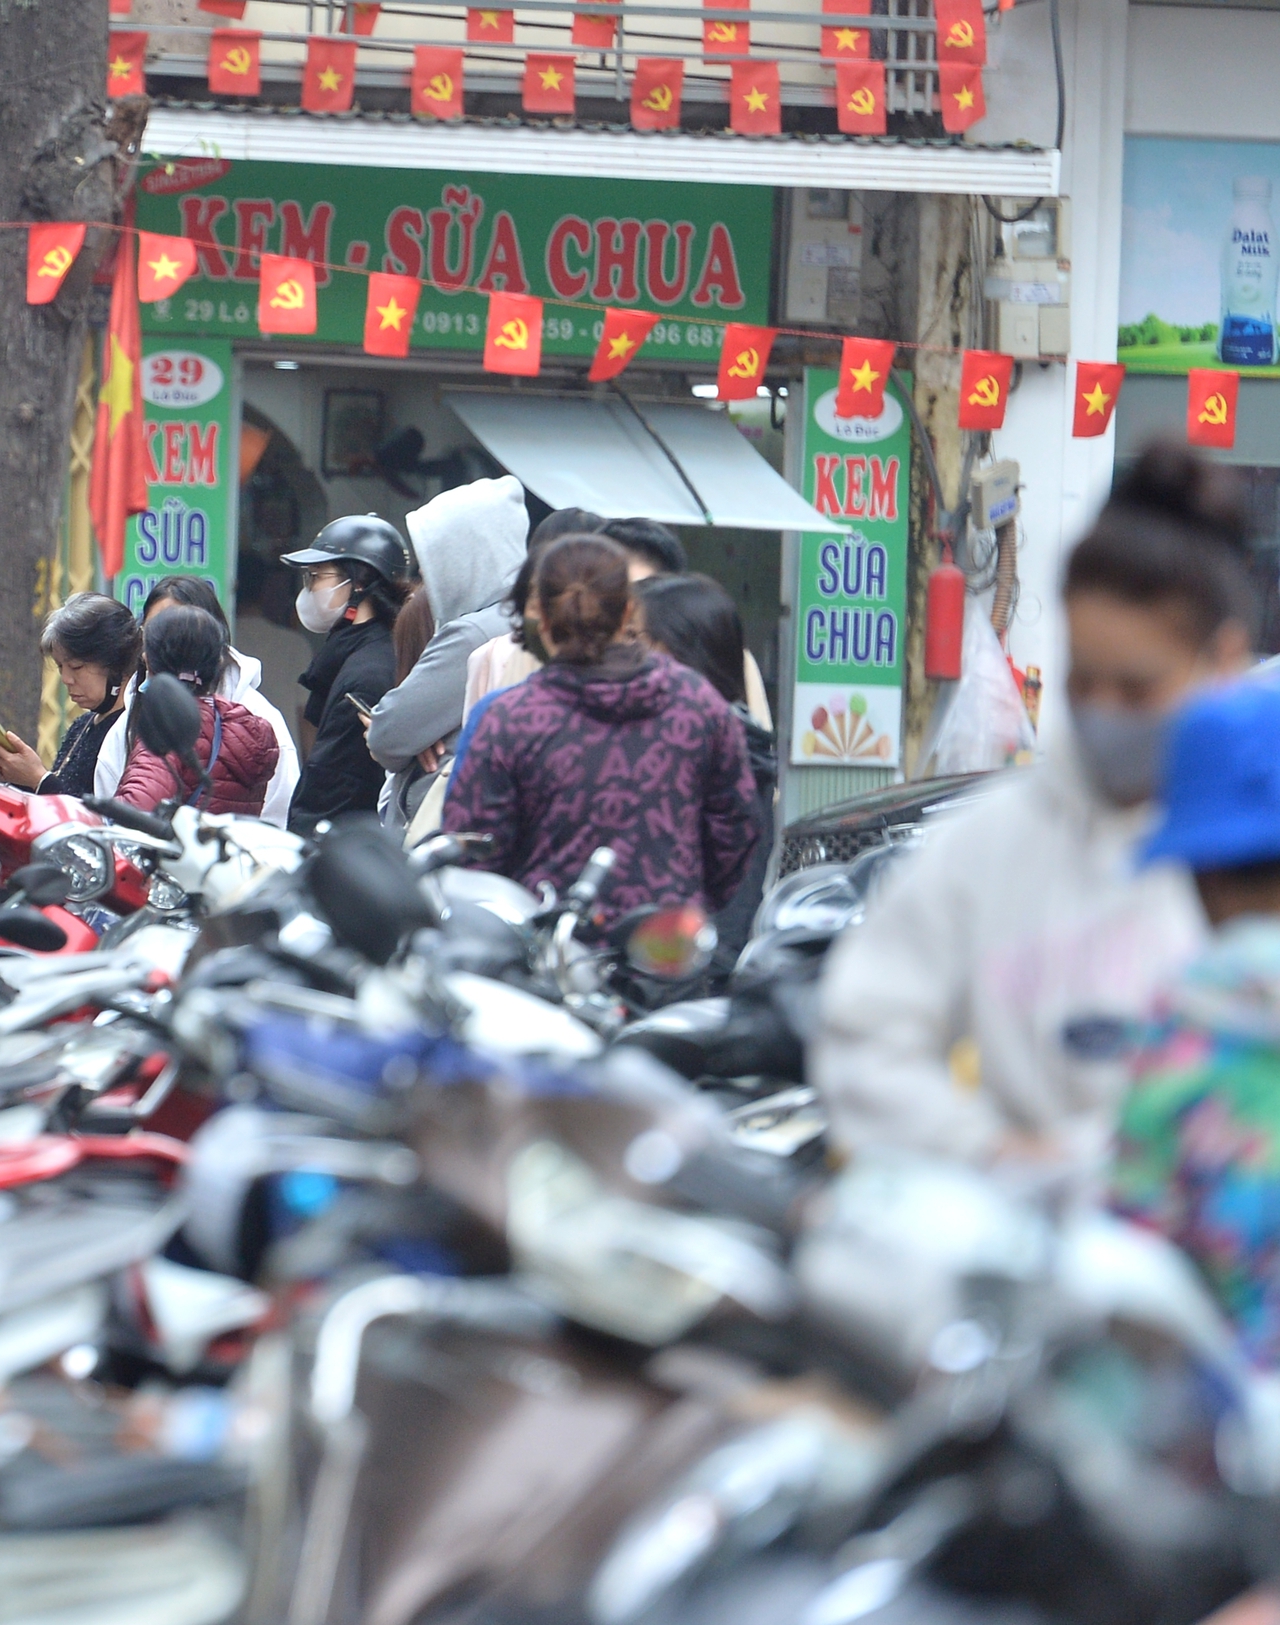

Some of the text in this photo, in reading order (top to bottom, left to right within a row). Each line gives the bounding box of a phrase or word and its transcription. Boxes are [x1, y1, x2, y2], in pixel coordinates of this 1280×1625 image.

[180, 195, 335, 287] KEM
[383, 183, 529, 294] SỮA
[546, 213, 746, 309] CHUA
[1241, 245, 1270, 257] Milk
[183, 299, 214, 322] 29
[422, 310, 481, 335] 0913
[150, 356, 204, 386] 29
[814, 454, 900, 521] KEM
[136, 497, 209, 568] SỮA
[818, 529, 888, 600] SỮA
[804, 604, 897, 668] CHUA
